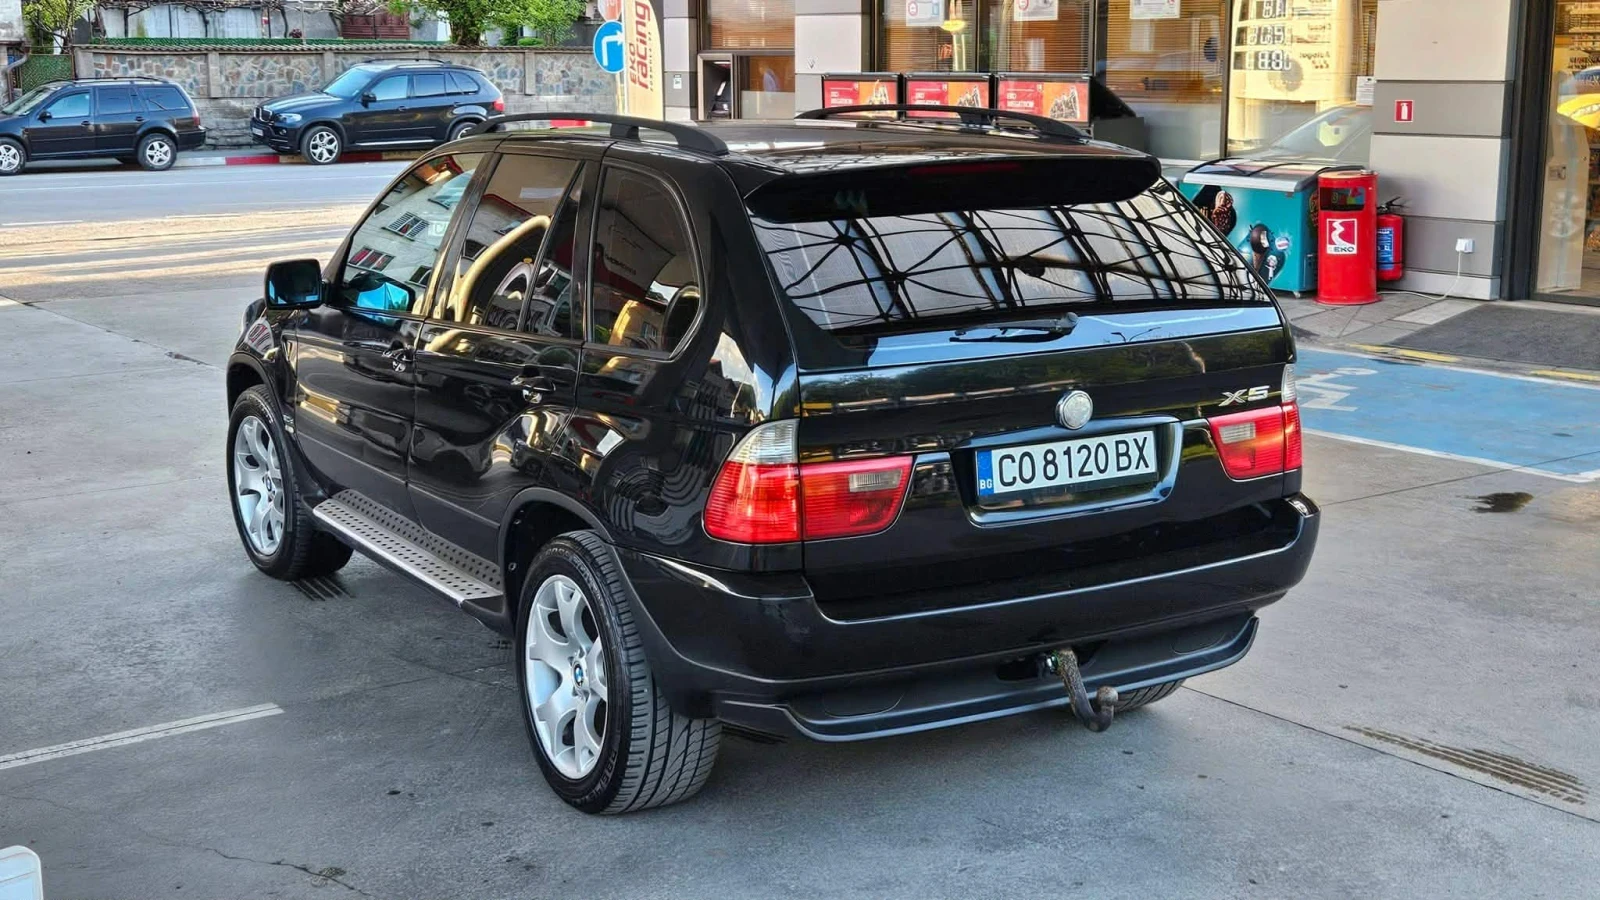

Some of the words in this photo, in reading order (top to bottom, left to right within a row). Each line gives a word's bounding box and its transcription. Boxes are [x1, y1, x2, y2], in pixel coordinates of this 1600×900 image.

[629, 43, 637, 84] EKO
[635, 1, 650, 89] racing
[1218, 385, 1270, 407] X5
[998, 451, 1036, 487] CO
[1043, 442, 1109, 481] 8120
[1115, 436, 1150, 472] BX
[979, 479, 993, 489] BG
